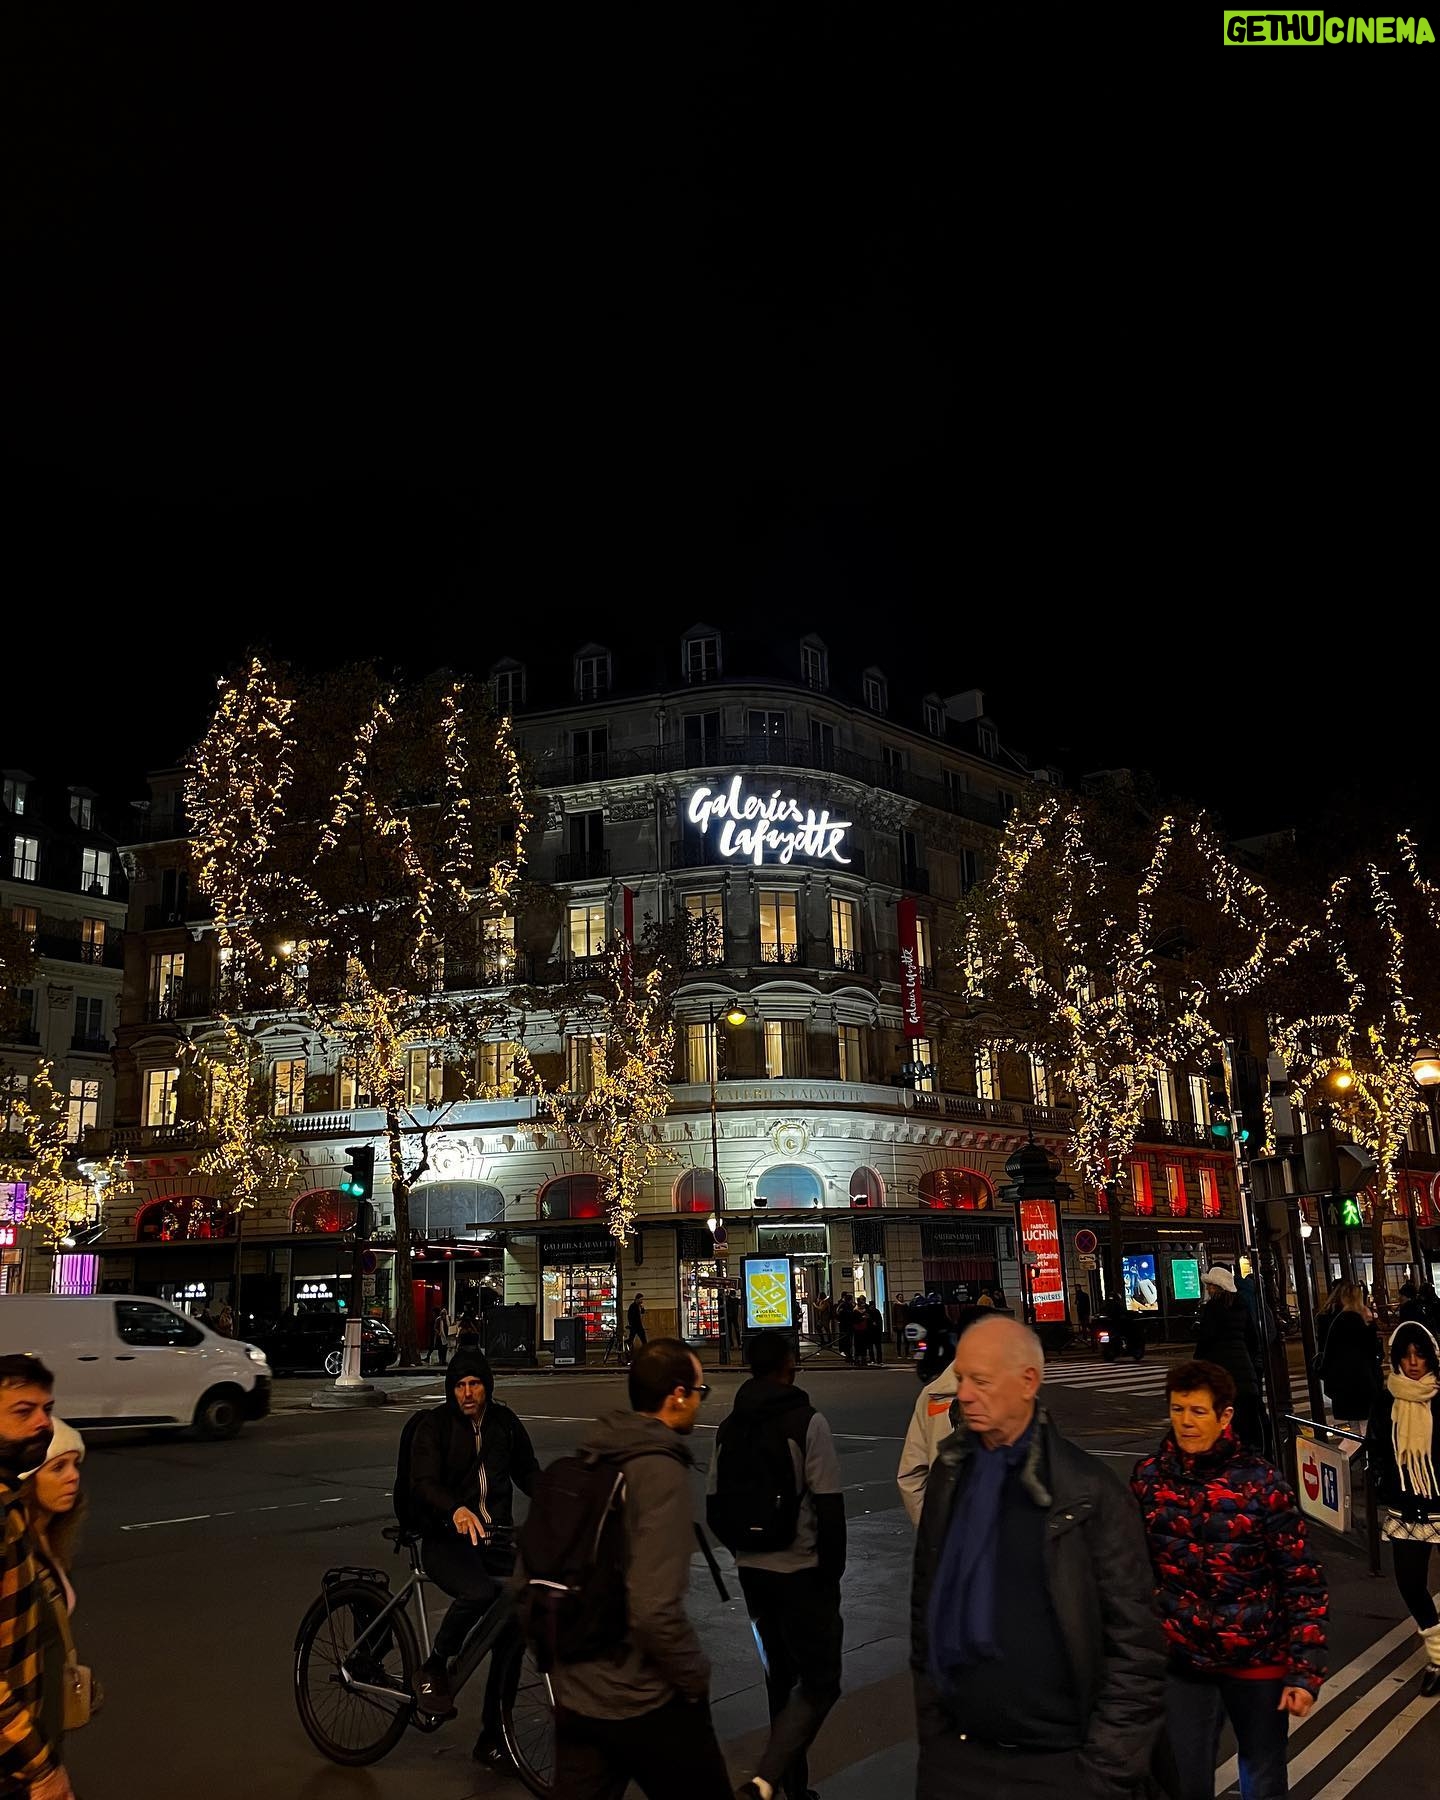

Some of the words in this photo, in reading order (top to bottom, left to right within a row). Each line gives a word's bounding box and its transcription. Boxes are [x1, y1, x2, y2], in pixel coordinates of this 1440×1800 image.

[688, 775, 803, 833] Galeries
[720, 809, 852, 866] Lafayette
[901, 947, 917, 987] Lafayette
[905, 989, 920, 1024] Galeries
[791, 1089, 864, 1100] LAFAYETTE
[1022, 1229, 1059, 1241] LUCHINI
